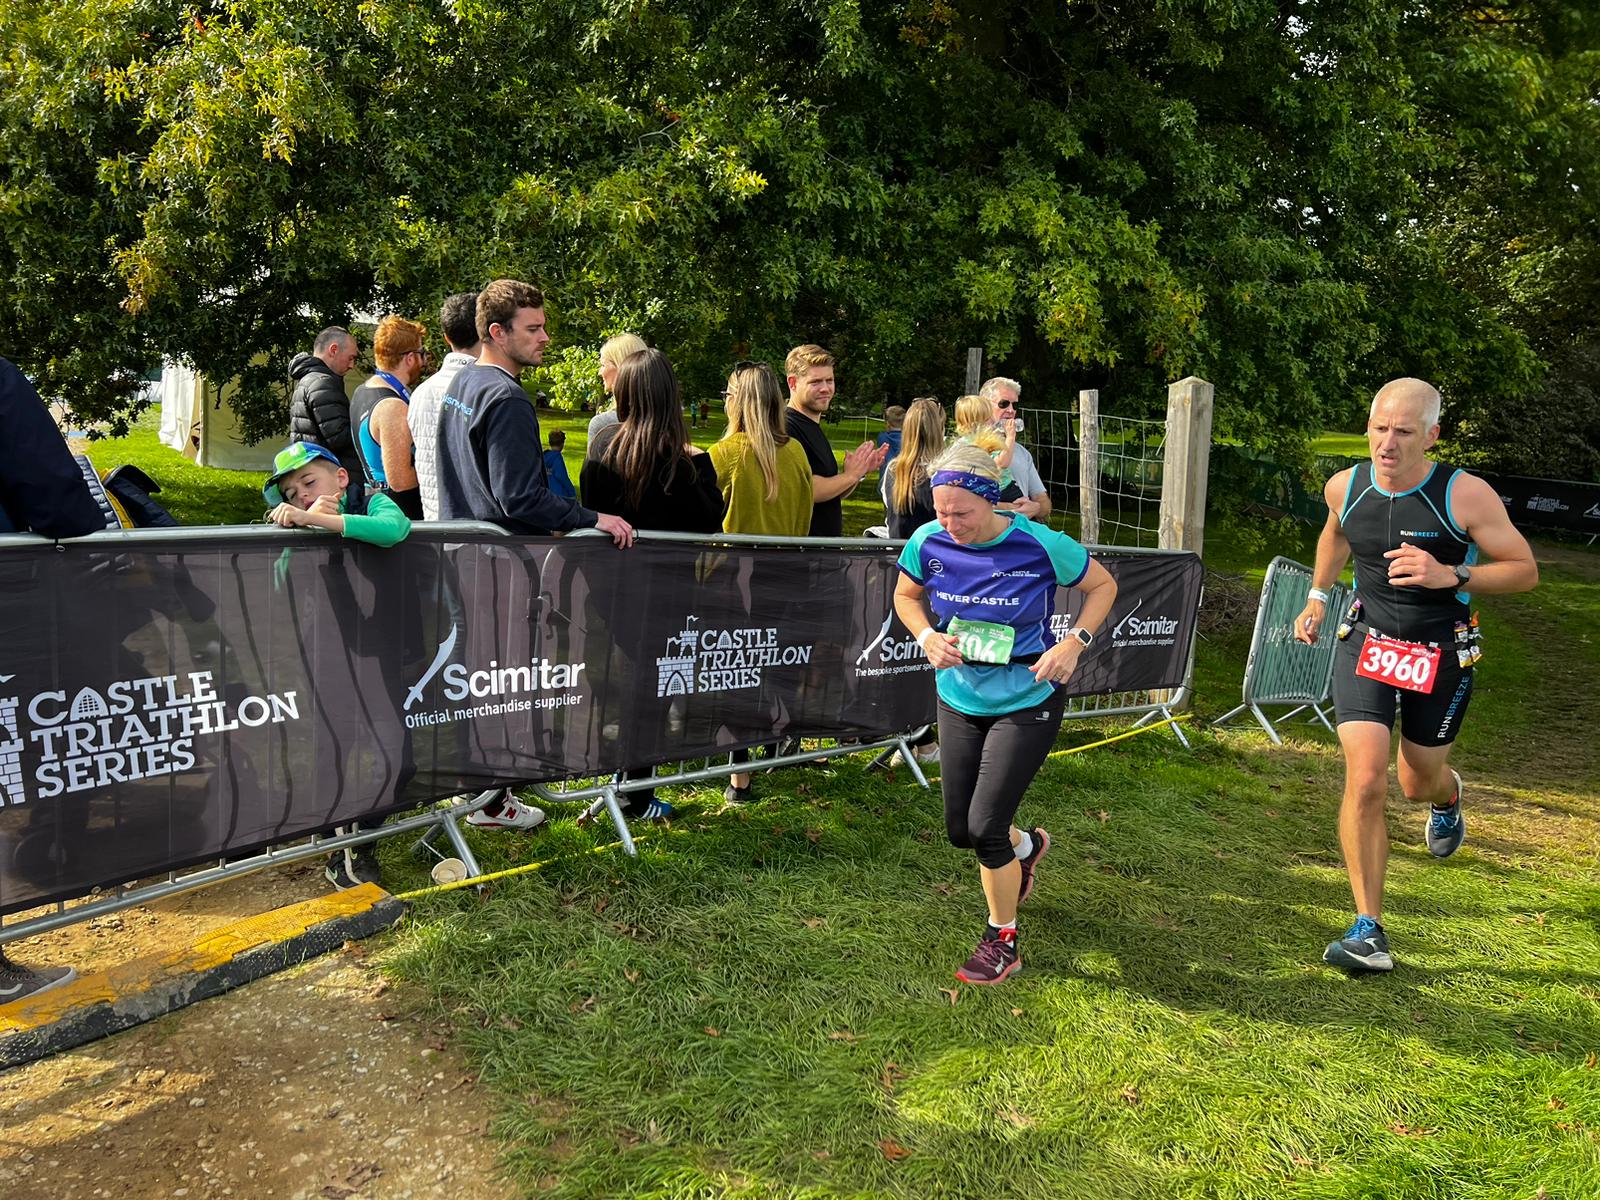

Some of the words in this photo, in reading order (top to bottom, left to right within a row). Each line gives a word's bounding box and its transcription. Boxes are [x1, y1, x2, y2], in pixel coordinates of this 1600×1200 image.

[936, 590, 970, 604] HEVER
[971, 596, 1020, 606] CASTLE
[700, 627, 778, 651] CASTLE
[1128, 615, 1179, 637] Scimitar
[699, 645, 813, 671] TRIATHLON
[855, 668, 867, 677] The
[867, 666, 892, 677] bespoke
[892, 664, 922, 675] sportswear
[1362, 646, 1431, 685] 3960
[442, 657, 586, 701] Scimitar
[697, 667, 762, 693] SERIES
[27, 670, 217, 726] CASTLE
[404, 708, 452, 729] Official
[454, 698, 532, 722] merchandise
[534, 693, 583, 709] supplier
[1437, 675, 1471, 739] RUNBREEZE
[30, 690, 300, 762] TRIATHLON
[35, 738, 196, 799] SERIES
